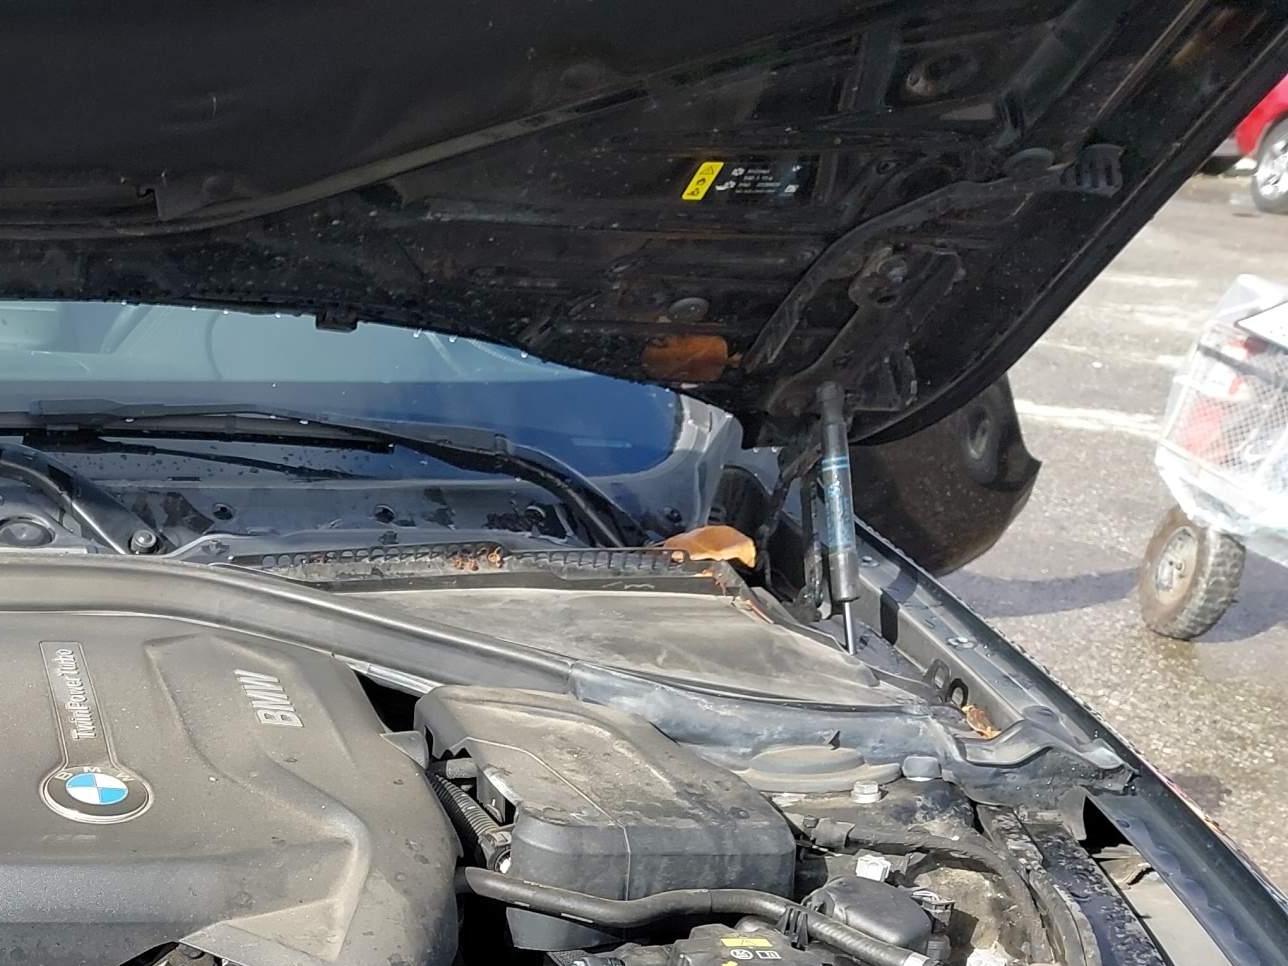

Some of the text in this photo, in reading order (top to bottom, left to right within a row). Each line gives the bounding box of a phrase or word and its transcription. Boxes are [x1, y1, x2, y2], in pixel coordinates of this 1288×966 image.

[52, 648, 97, 741] TwinPower Turbo
[233, 669, 305, 728] BMW
[54, 766, 136, 782] BMW
